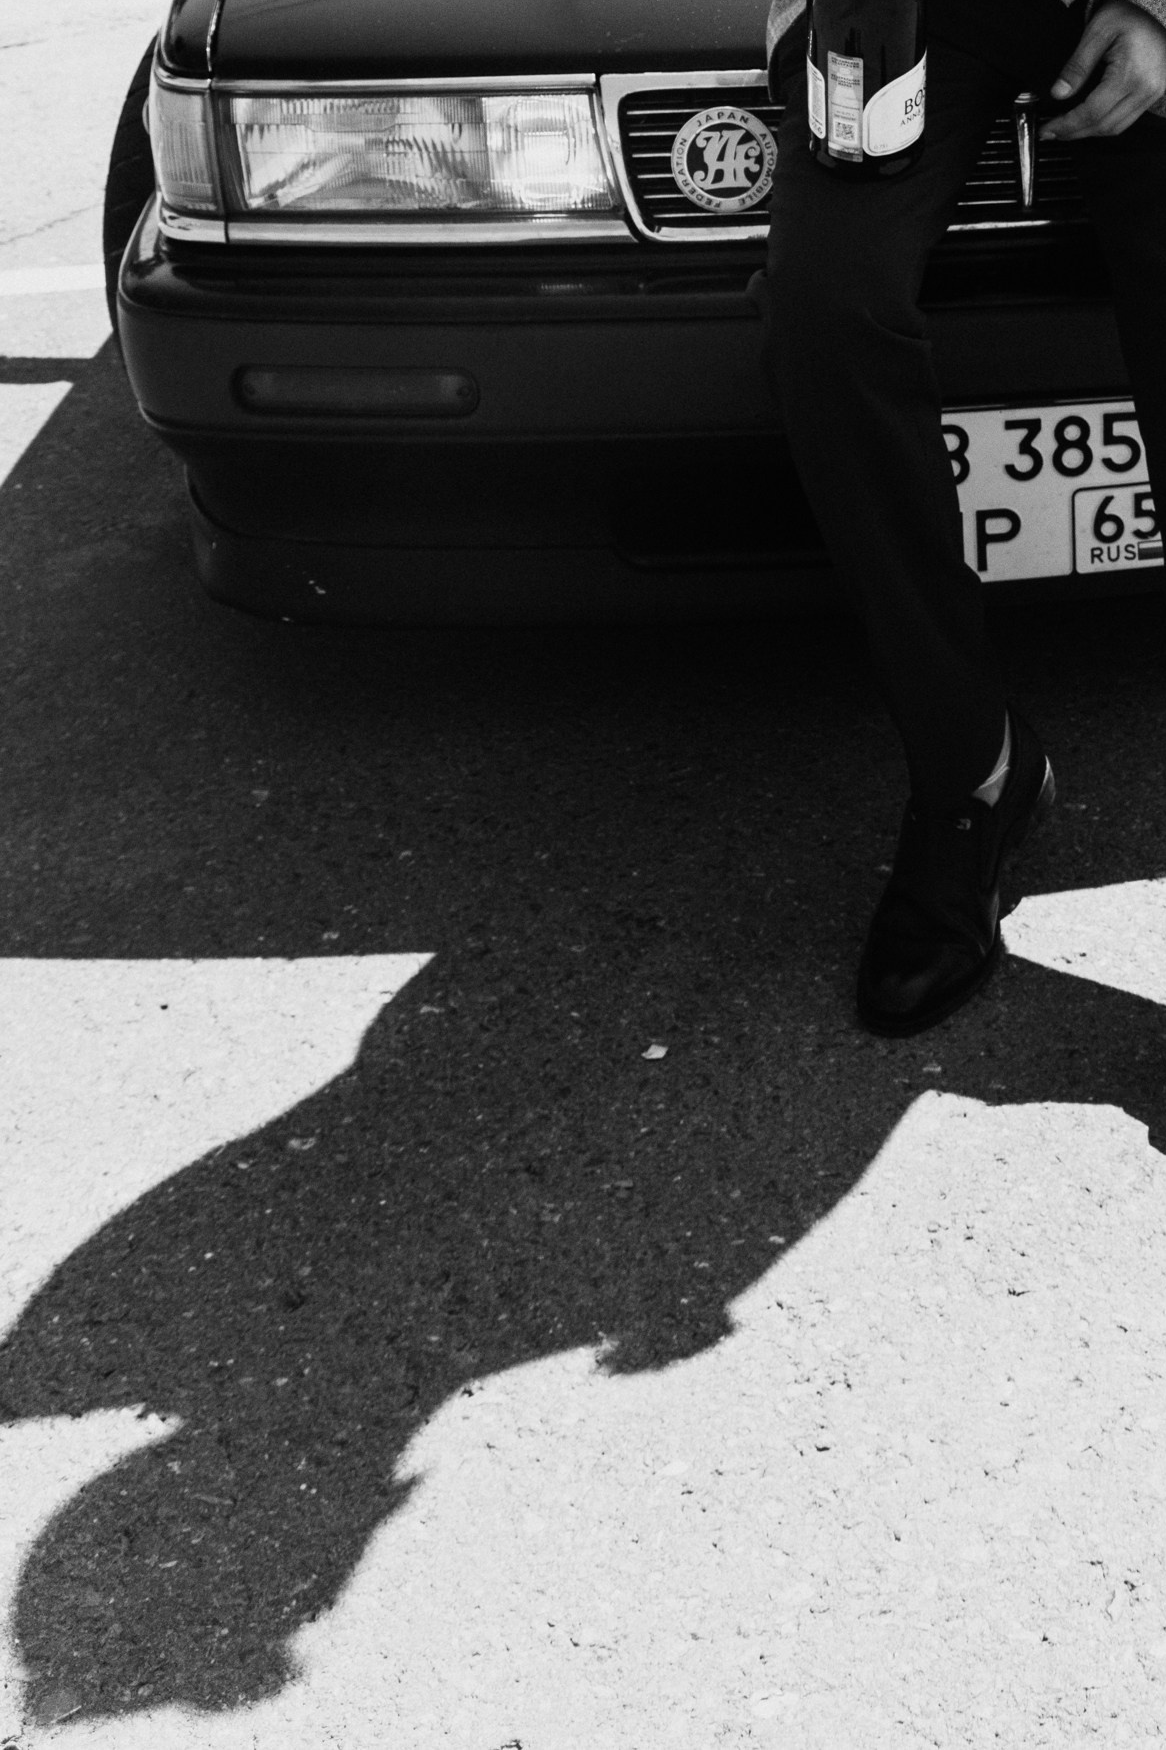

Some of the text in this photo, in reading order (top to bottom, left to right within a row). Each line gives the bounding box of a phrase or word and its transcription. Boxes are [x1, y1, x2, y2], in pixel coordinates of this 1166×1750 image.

[676, 112, 775, 208] JAPAN AUTOMOBILE FEDERATION
[1004, 411, 1142, 482] 385
[1093, 491, 1160, 544] 65
[1090, 544, 1137, 564] RUS
